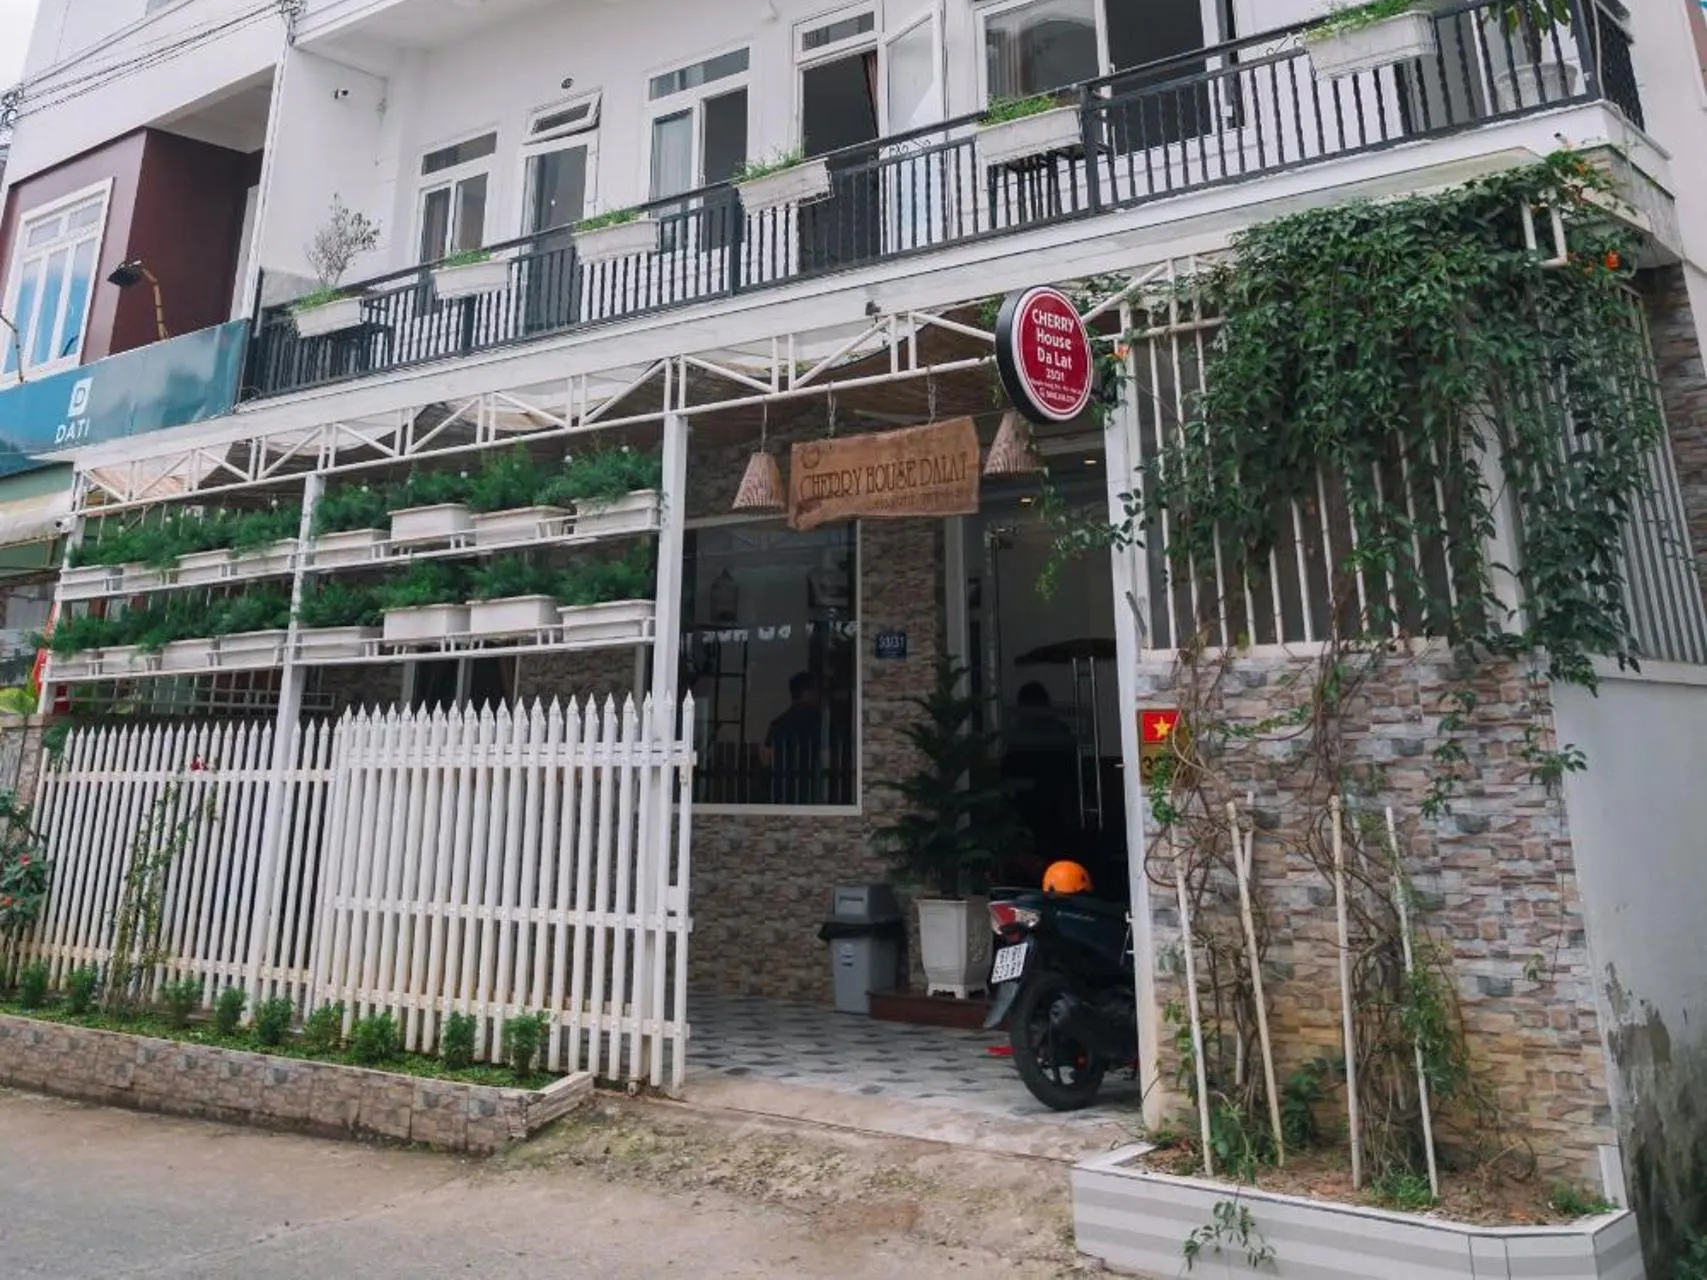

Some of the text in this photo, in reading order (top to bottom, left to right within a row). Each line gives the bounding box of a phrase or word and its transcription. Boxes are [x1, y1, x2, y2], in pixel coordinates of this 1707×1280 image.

[1032, 310, 1074, 333] CHERRY
[1036, 327, 1072, 351] House
[1037, 347, 1073, 370] Da Lat
[55, 418, 90, 443] DATI
[801, 467, 862, 501] CHERRY
[866, 459, 916, 494] HOUSE
